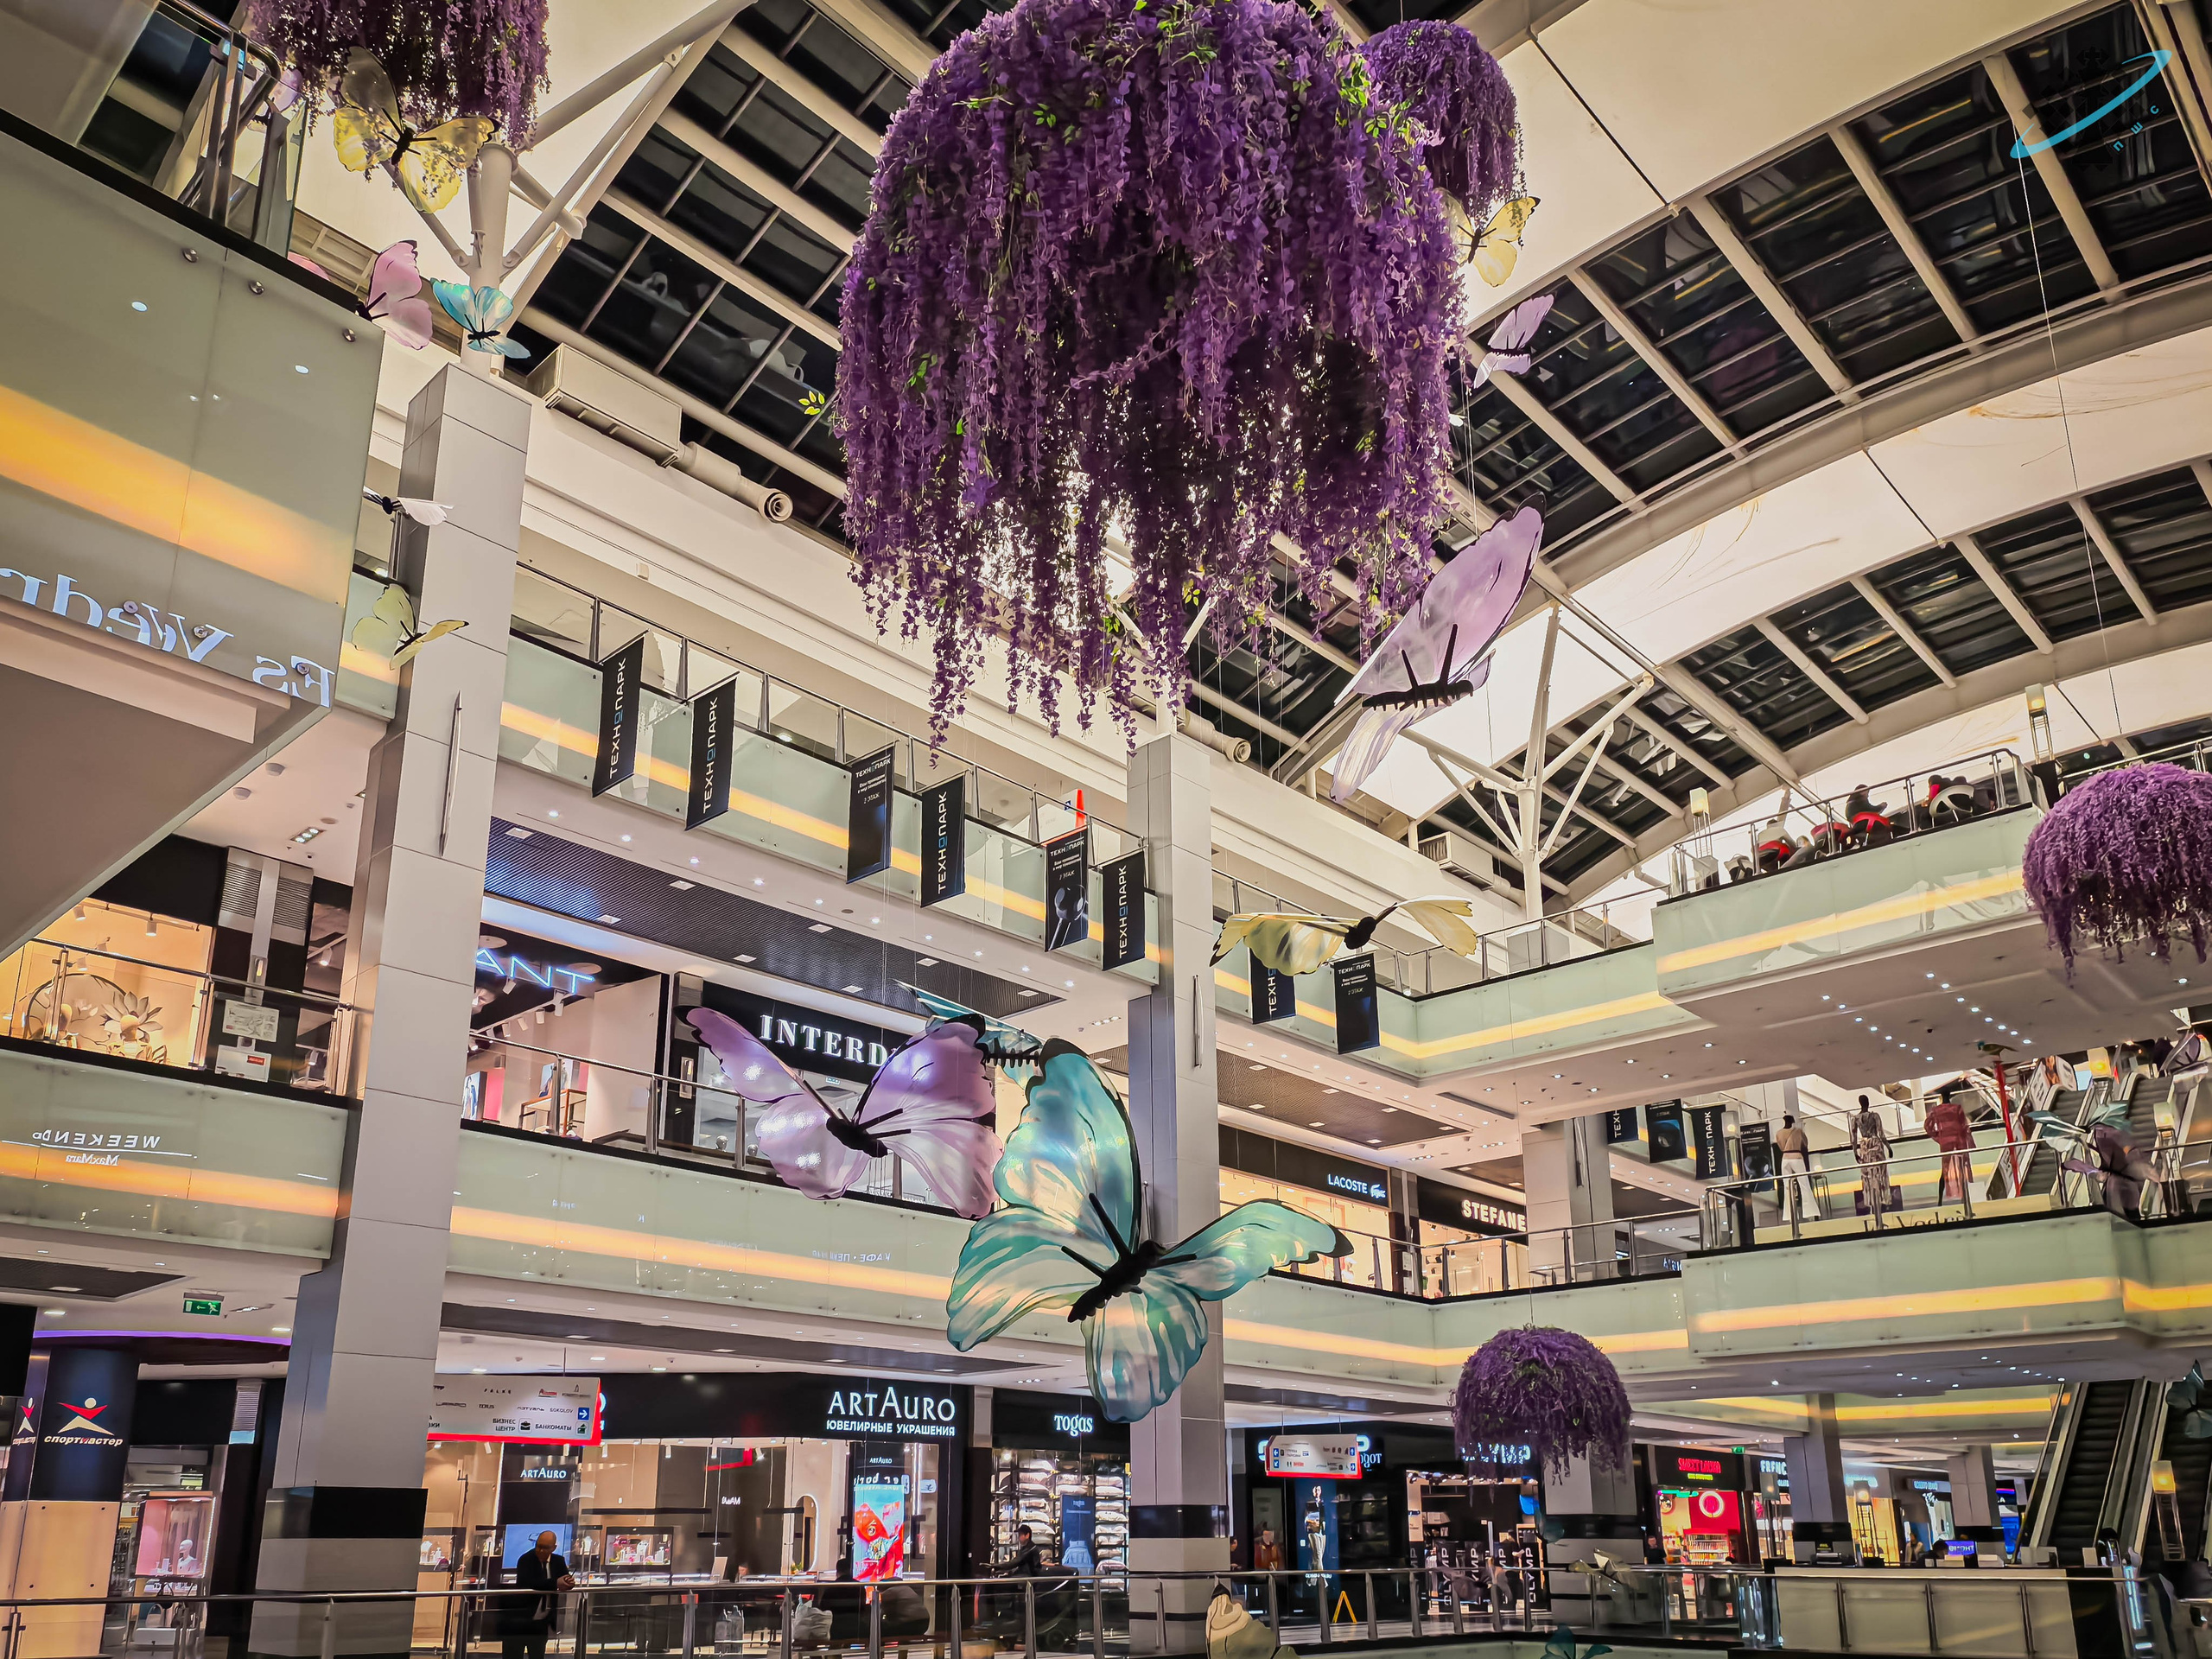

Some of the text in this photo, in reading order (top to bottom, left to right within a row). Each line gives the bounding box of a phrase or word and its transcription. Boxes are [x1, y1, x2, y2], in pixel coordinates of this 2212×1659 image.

[608, 657, 626, 779] ТЕХНОПАРК
[702, 696, 719, 814] ТЕХНОПАРК
[855, 757, 891, 778] ТЕХНОПАРК
[937, 791, 948, 894] ТЕХНОПАРК
[1050, 839, 1085, 856] ТЕХНОПАРК
[1118, 864, 1128, 959] ТЕХНОПАРК
[1268, 968, 1277, 1014] ТЕХНО
[1338, 962, 1371, 975] ТЕХНОПАРК
[759, 1014, 897, 1067] INTERD
[1704, 1111, 1716, 1174] ТЕХНОПАРК
[1327, 1173, 1368, 1194] LACOSTE
[1461, 1199, 1528, 1232] STEFANE
[826, 1420, 956, 1437] ЮВЕЛИРНЫЕ УКРАШЕНИЯ
